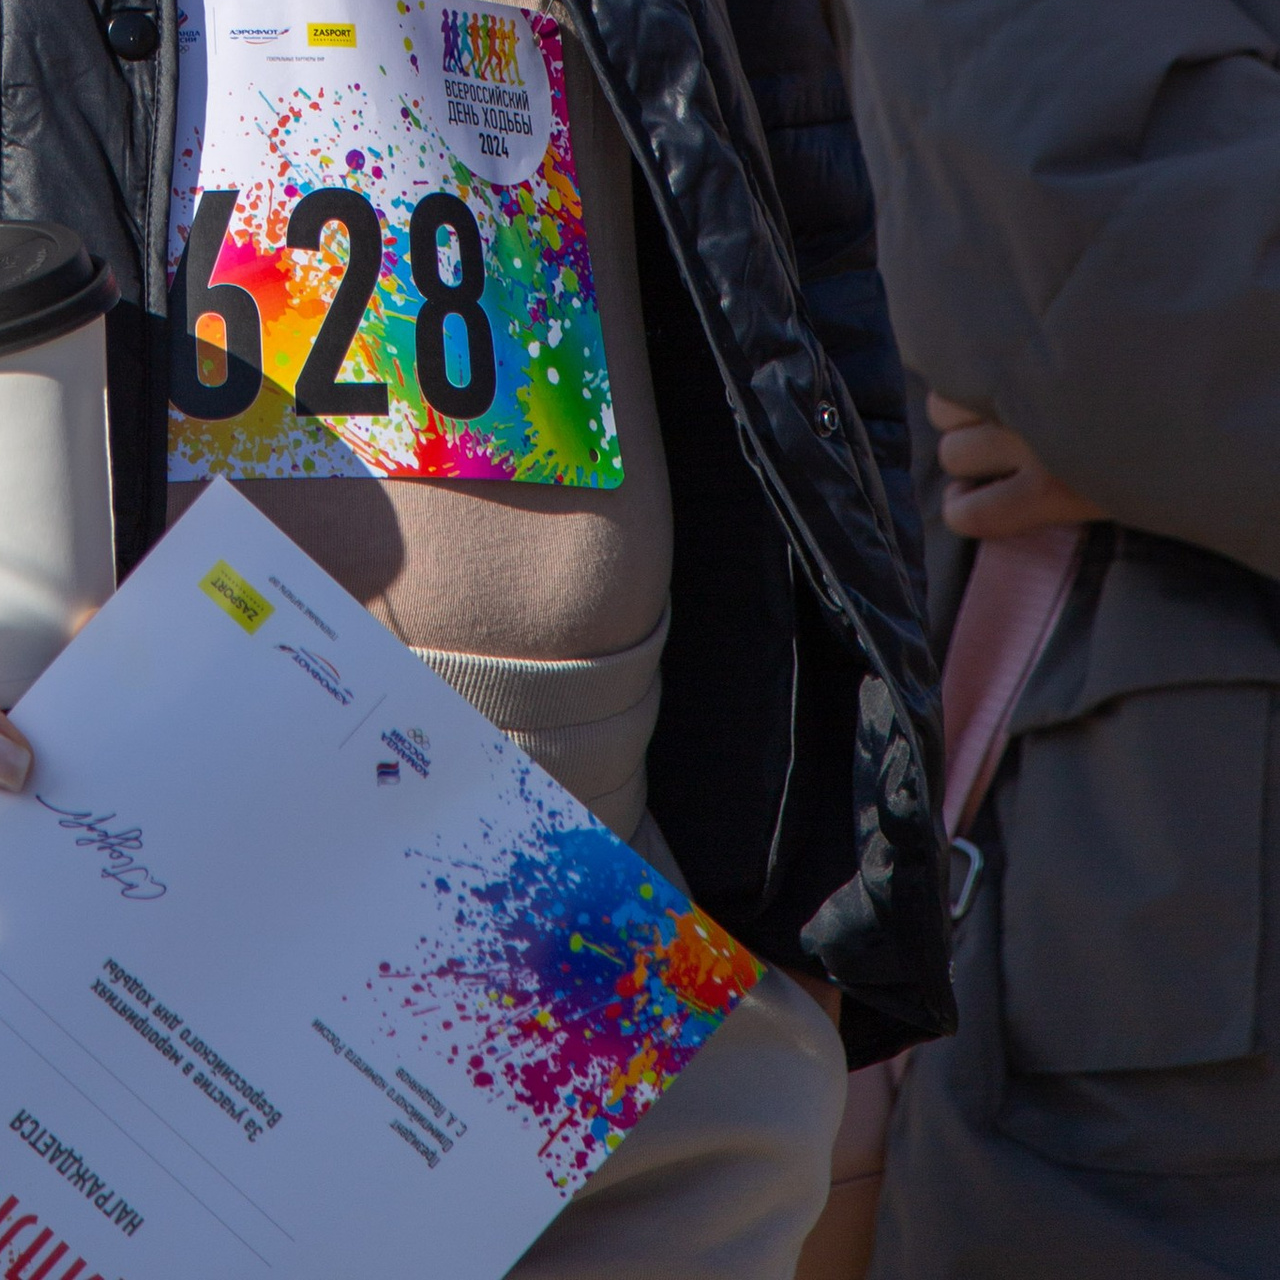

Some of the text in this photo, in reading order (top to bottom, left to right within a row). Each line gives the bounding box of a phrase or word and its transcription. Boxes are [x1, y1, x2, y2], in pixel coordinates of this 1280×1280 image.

[313, 28, 352, 38] ZASPORT
[444, 79, 530, 112] ВСЕРОССИЙСКИЙ
[448, 100, 533, 136] ДЕНЬ ХОДЬБЫ
[479, 132, 509, 159] 2024
[168, 187, 499, 421] 628
[211, 577, 259, 622] ZASPORT
[292, 651, 350, 706] АЭРОФЛОТ
[381, 732, 430, 779] КОМАНДА
[390, 729, 431, 768] РОССИИ
[90, 978, 264, 1143] За участие в мероприятиях
[102, 957, 282, 1128] Всероссийского дня ходьбы
[311, 1018, 454, 1153] Олимпийского комитета России
[395, 1067, 447, 1119] Поздняков
[389, 1120, 440, 1170] Президент
[9, 1108, 145, 1237] НАГРАЖДАЕТСЯ
